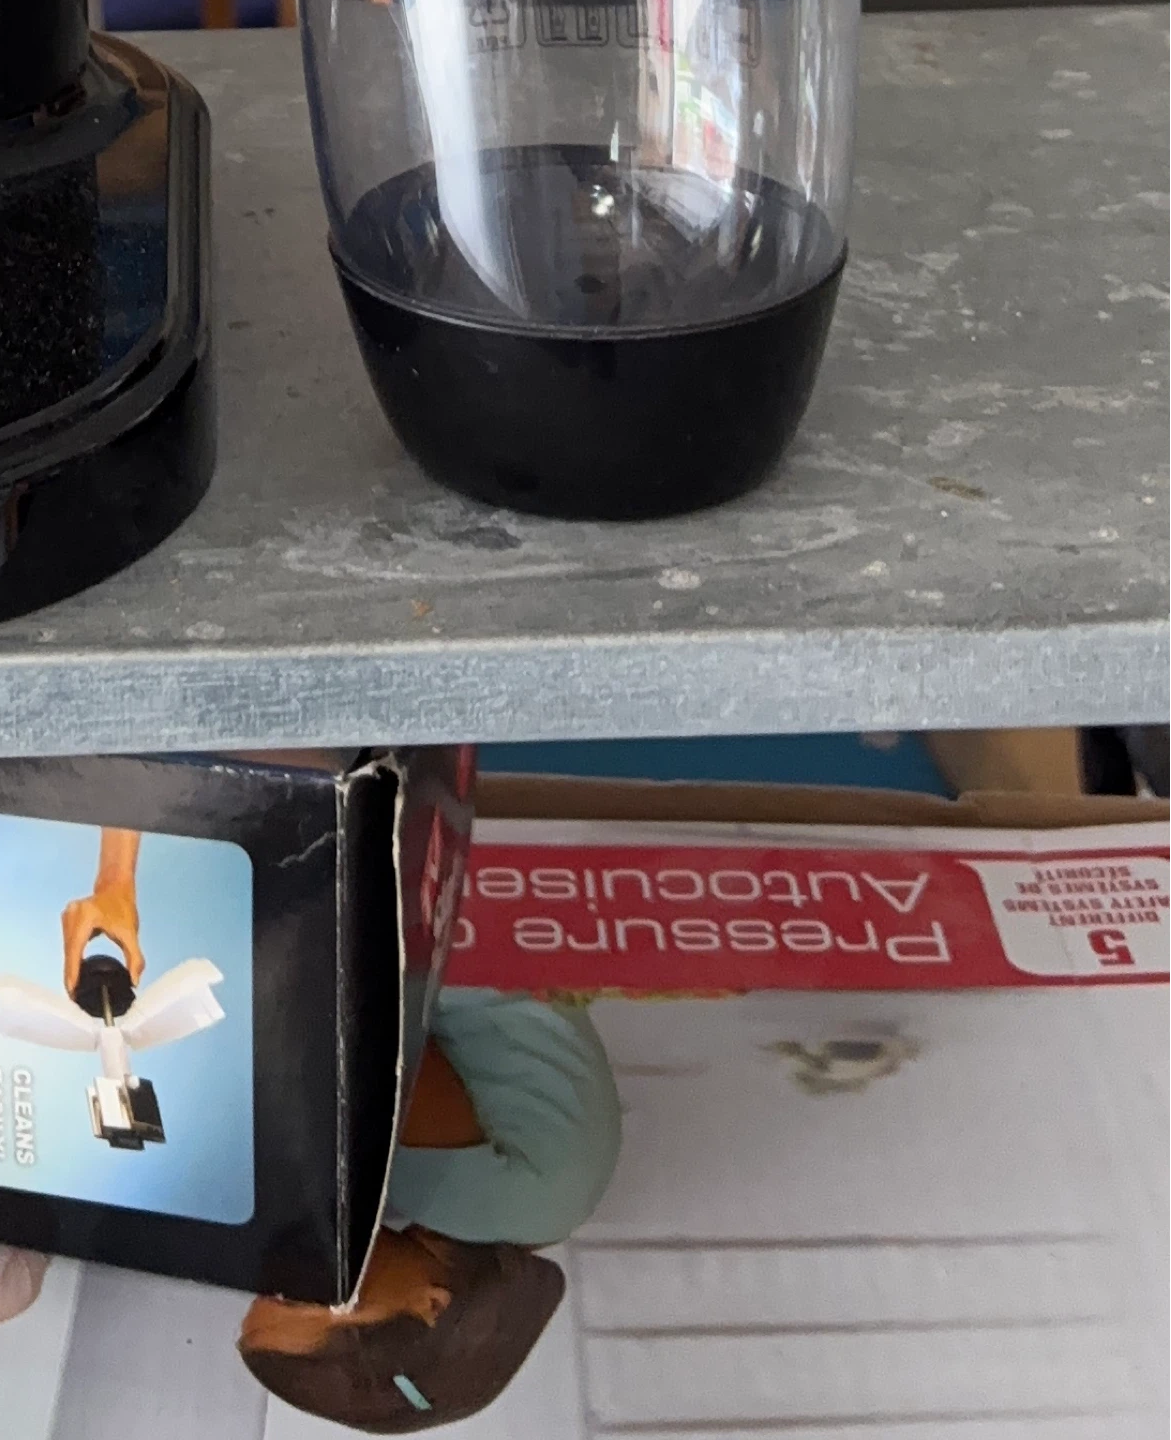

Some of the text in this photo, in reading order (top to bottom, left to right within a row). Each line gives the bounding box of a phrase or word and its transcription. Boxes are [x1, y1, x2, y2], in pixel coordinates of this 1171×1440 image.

[462, 867, 930, 914] Autocuise
[1002, 898, 1103, 913] SYSTEMS
[1049, 911, 1160, 927] DIFFERENT
[512, 917, 952, 964] Pressure
[1087, 929, 1136, 966] 5
[12, 1069, 35, 1165] CLEANS
